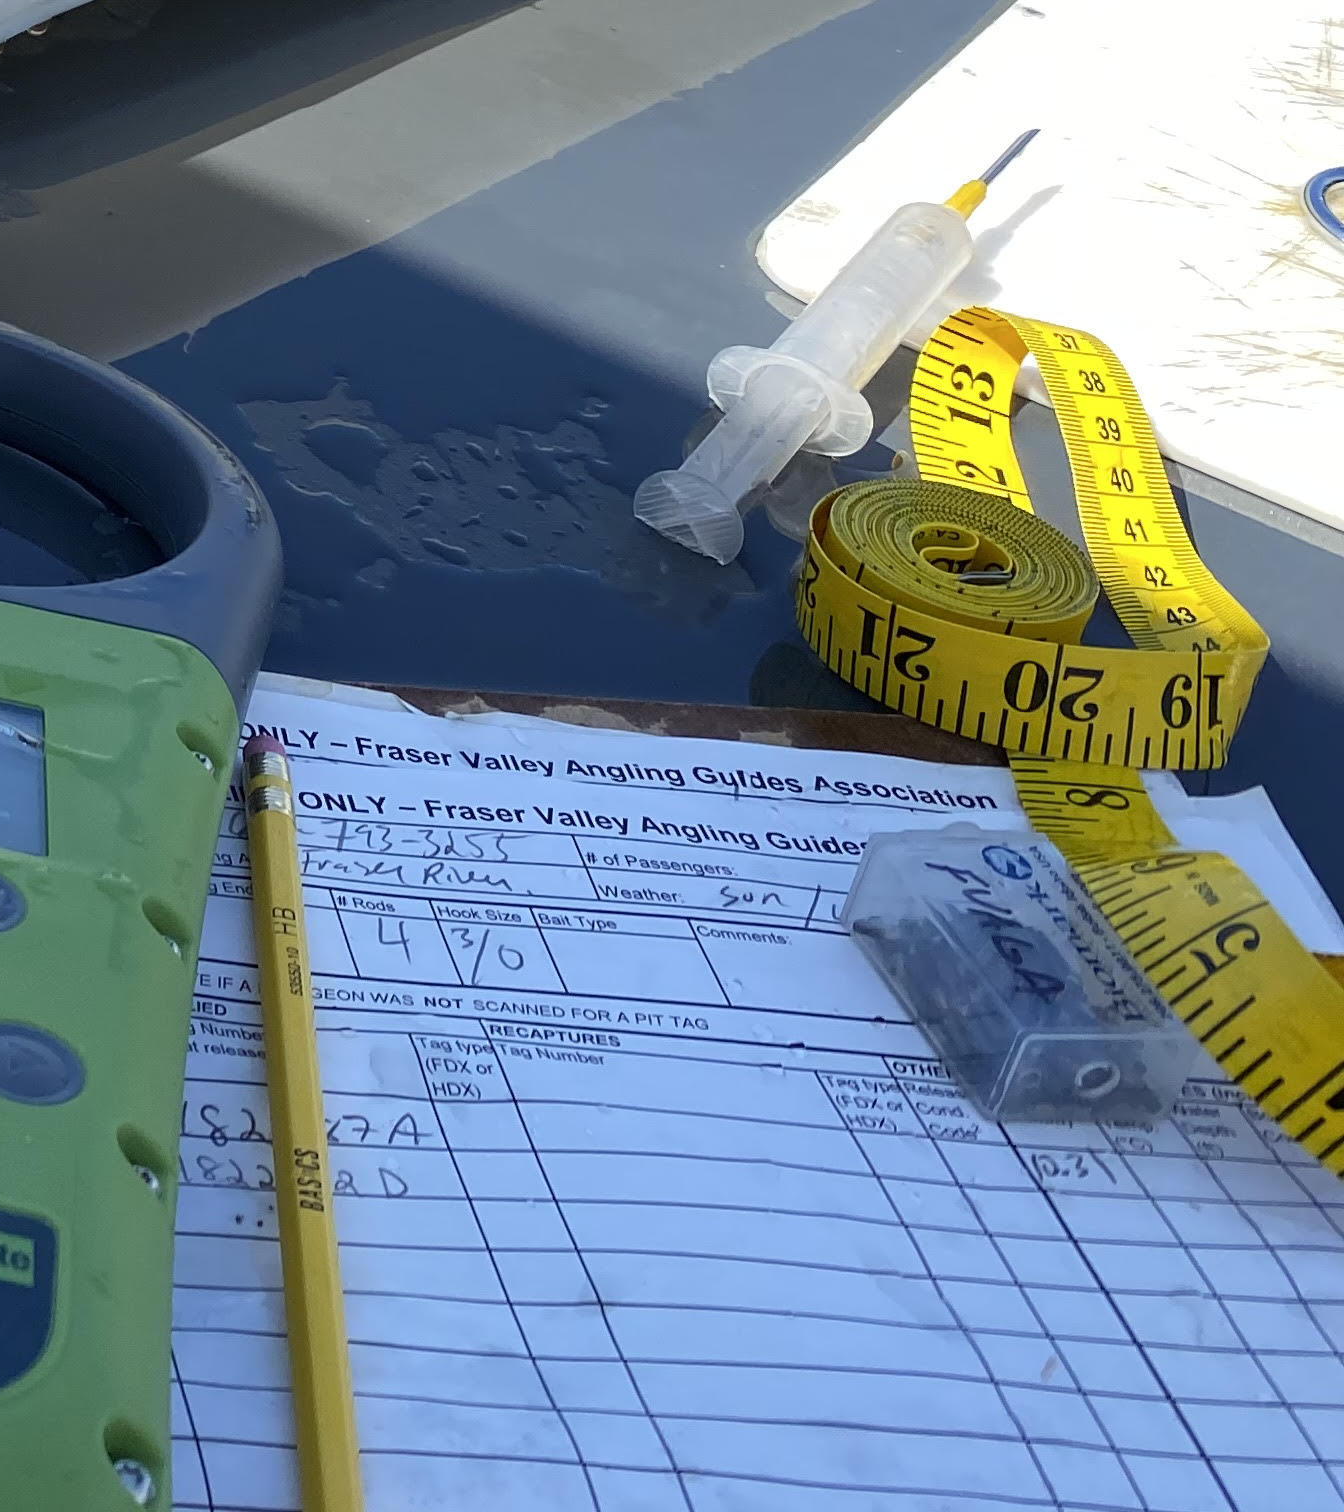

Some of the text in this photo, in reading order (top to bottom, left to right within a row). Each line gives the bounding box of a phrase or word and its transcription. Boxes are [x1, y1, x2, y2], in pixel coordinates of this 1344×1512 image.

[1052, 332, 1081, 352] 37
[1078, 369, 1106, 394] 38
[946, 363, 996, 435] 13
[1095, 416, 1122, 442] 39
[1109, 466, 1135, 493] 40
[1123, 517, 1150, 543] 41
[1143, 565, 1174, 588] 42
[1165, 606, 1198, 626] 43
[855, 603, 937, 683] 21
[1003, 659, 1105, 723] 20
[1160, 672, 1226, 730] 19
[354, 736, 453, 767] Fraser
[458, 750, 554, 778] Valley
[566, 758, 686, 787] Angling
[692, 766, 804, 794] Guides
[814, 775, 999, 810] Association
[298, 790, 387, 815] ONLY
[423, 799, 526, 824] Fraser
[533, 806, 629, 836] Valley
[641, 815, 761, 851] Angling
[603, 853, 620, 866] of
[624, 854, 739, 877] Passengers:
[352, 896, 396, 913] Rods
[598, 884, 685, 905] Weather:
[271, 905, 299, 938] HB
[437, 905, 522, 923] Hook Size
[538, 912, 617, 932] Bait Type
[378, 917, 412, 965] 4
[696, 924, 793, 946] Comments:
[1190, 922, 1261, 979] 5
[217, 976, 234, 989] IF
[239, 979, 252, 993] A
[370, 992, 414, 1006] WAS
[423, 996, 464, 1009] NOT
[473, 999, 566, 1018] SCANNED
[570, 1009, 612, 1023] FOR
[617, 1011, 630, 1024] A
[634, 1012, 665, 1026] PIT
[668, 1014, 710, 1030] TAG
[419, 1037, 494, 1056] Tag type
[489, 1023, 621, 1048] RECAPTURES
[425, 1057, 493, 1075] (FDX or
[499, 1043, 606, 1066] Tag Number
[432, 1082, 482, 1101] HDX)
[294, 1147, 325, 1213] BASCS
